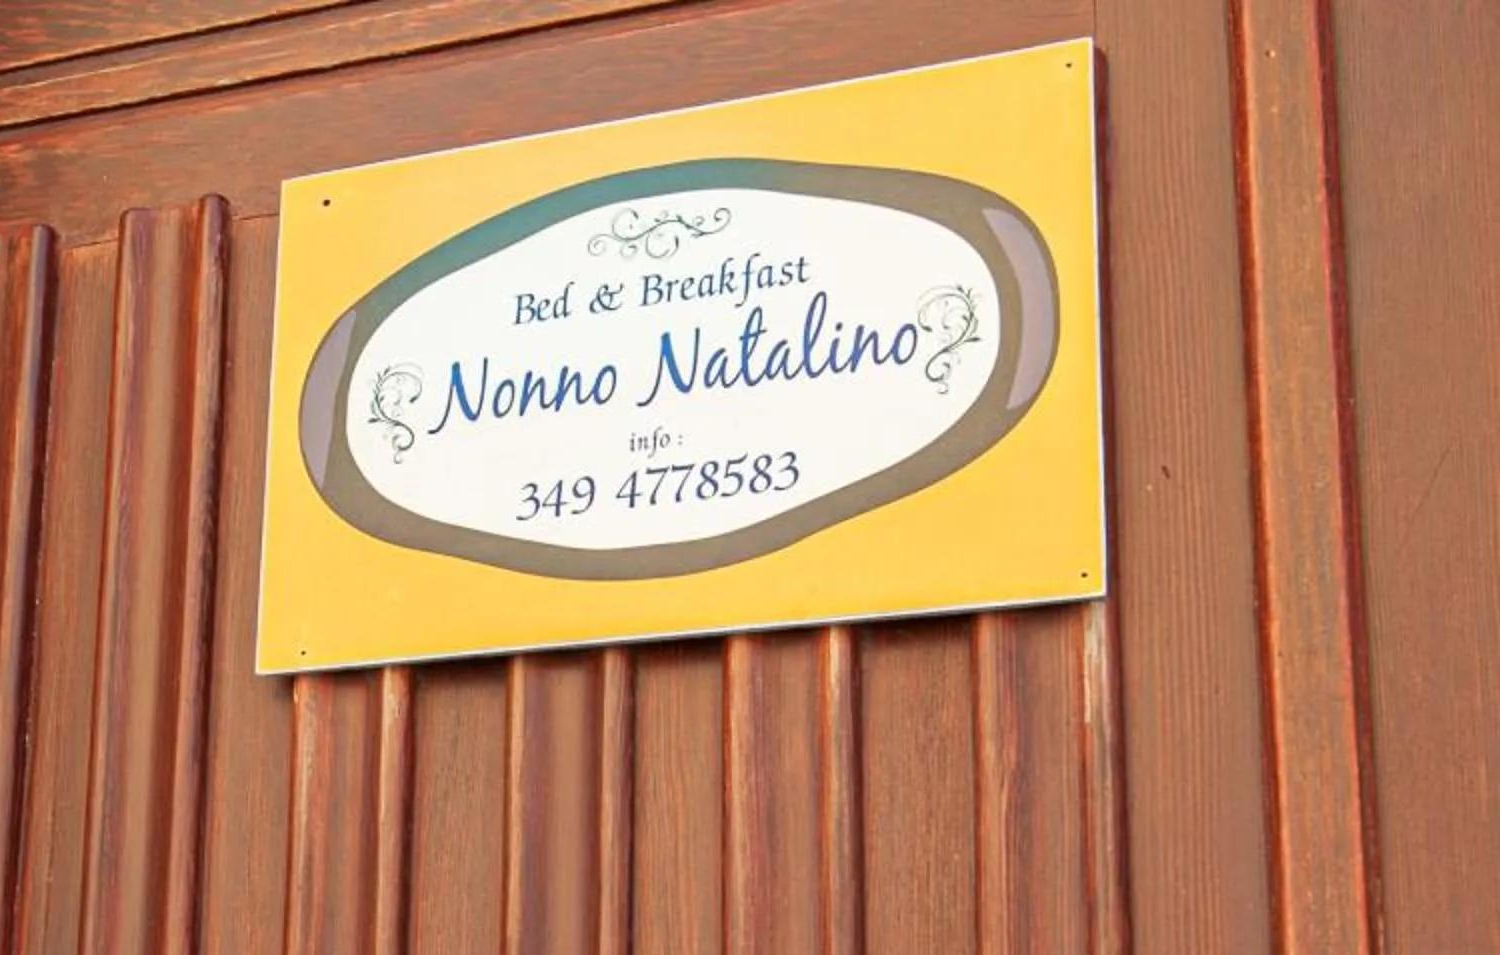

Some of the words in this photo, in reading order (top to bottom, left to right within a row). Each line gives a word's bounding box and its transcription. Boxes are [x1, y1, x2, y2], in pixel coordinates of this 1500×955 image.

[513, 281, 575, 326] Bed
[589, 283, 624, 313] &
[638, 252, 811, 308] Breakfast
[427, 357, 618, 434] Nonno
[635, 291, 918, 408] Natalino
[515, 475, 596, 522] 349
[615, 451, 800, 509] 4778583
